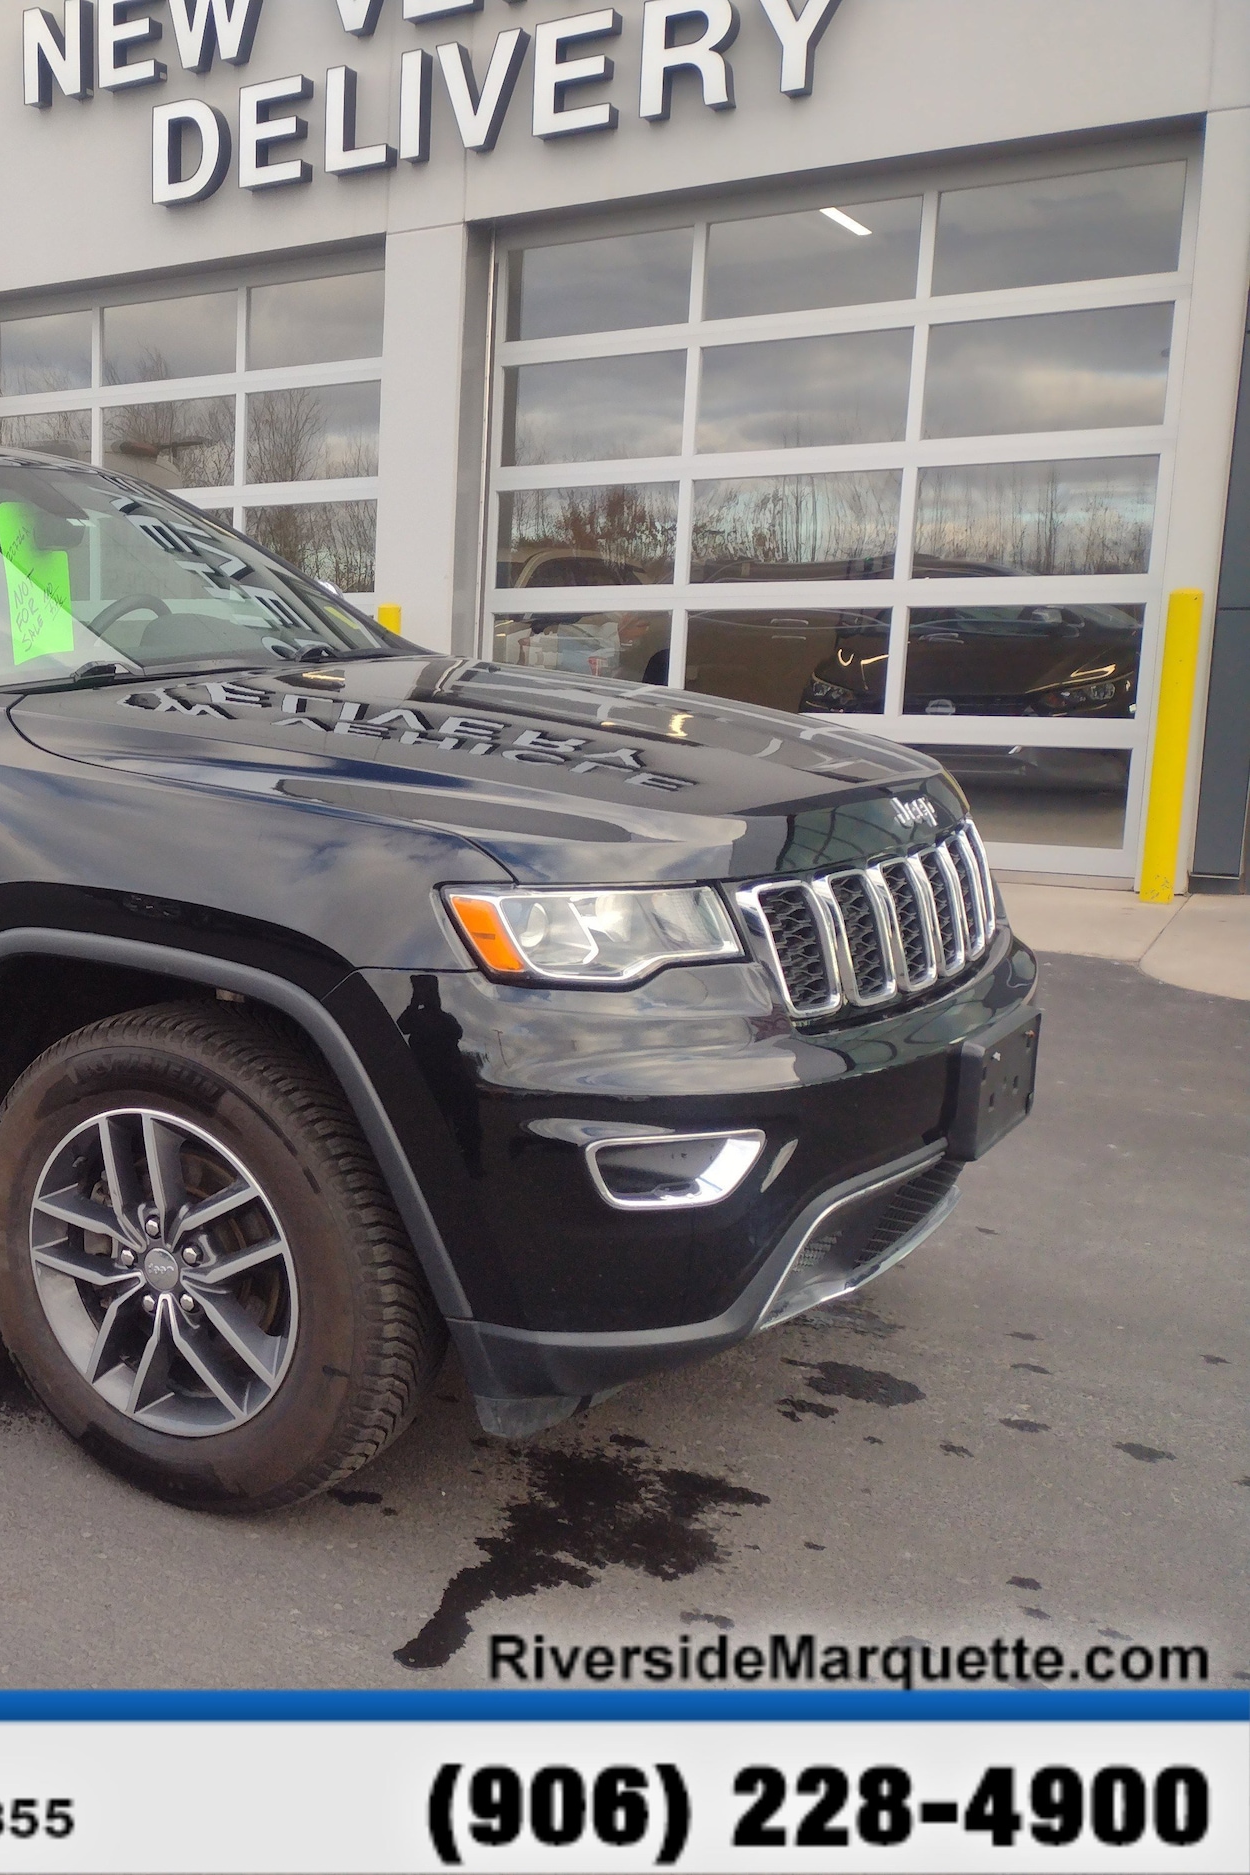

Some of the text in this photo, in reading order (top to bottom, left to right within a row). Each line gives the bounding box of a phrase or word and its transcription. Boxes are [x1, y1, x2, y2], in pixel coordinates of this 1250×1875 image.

[22, 0, 252, 109] NEW
[151, 0, 840, 208] DELIVERY
[13, 568, 35, 609] NOT
[15, 597, 39, 632] FOR
[21, 616, 44, 652] SALE
